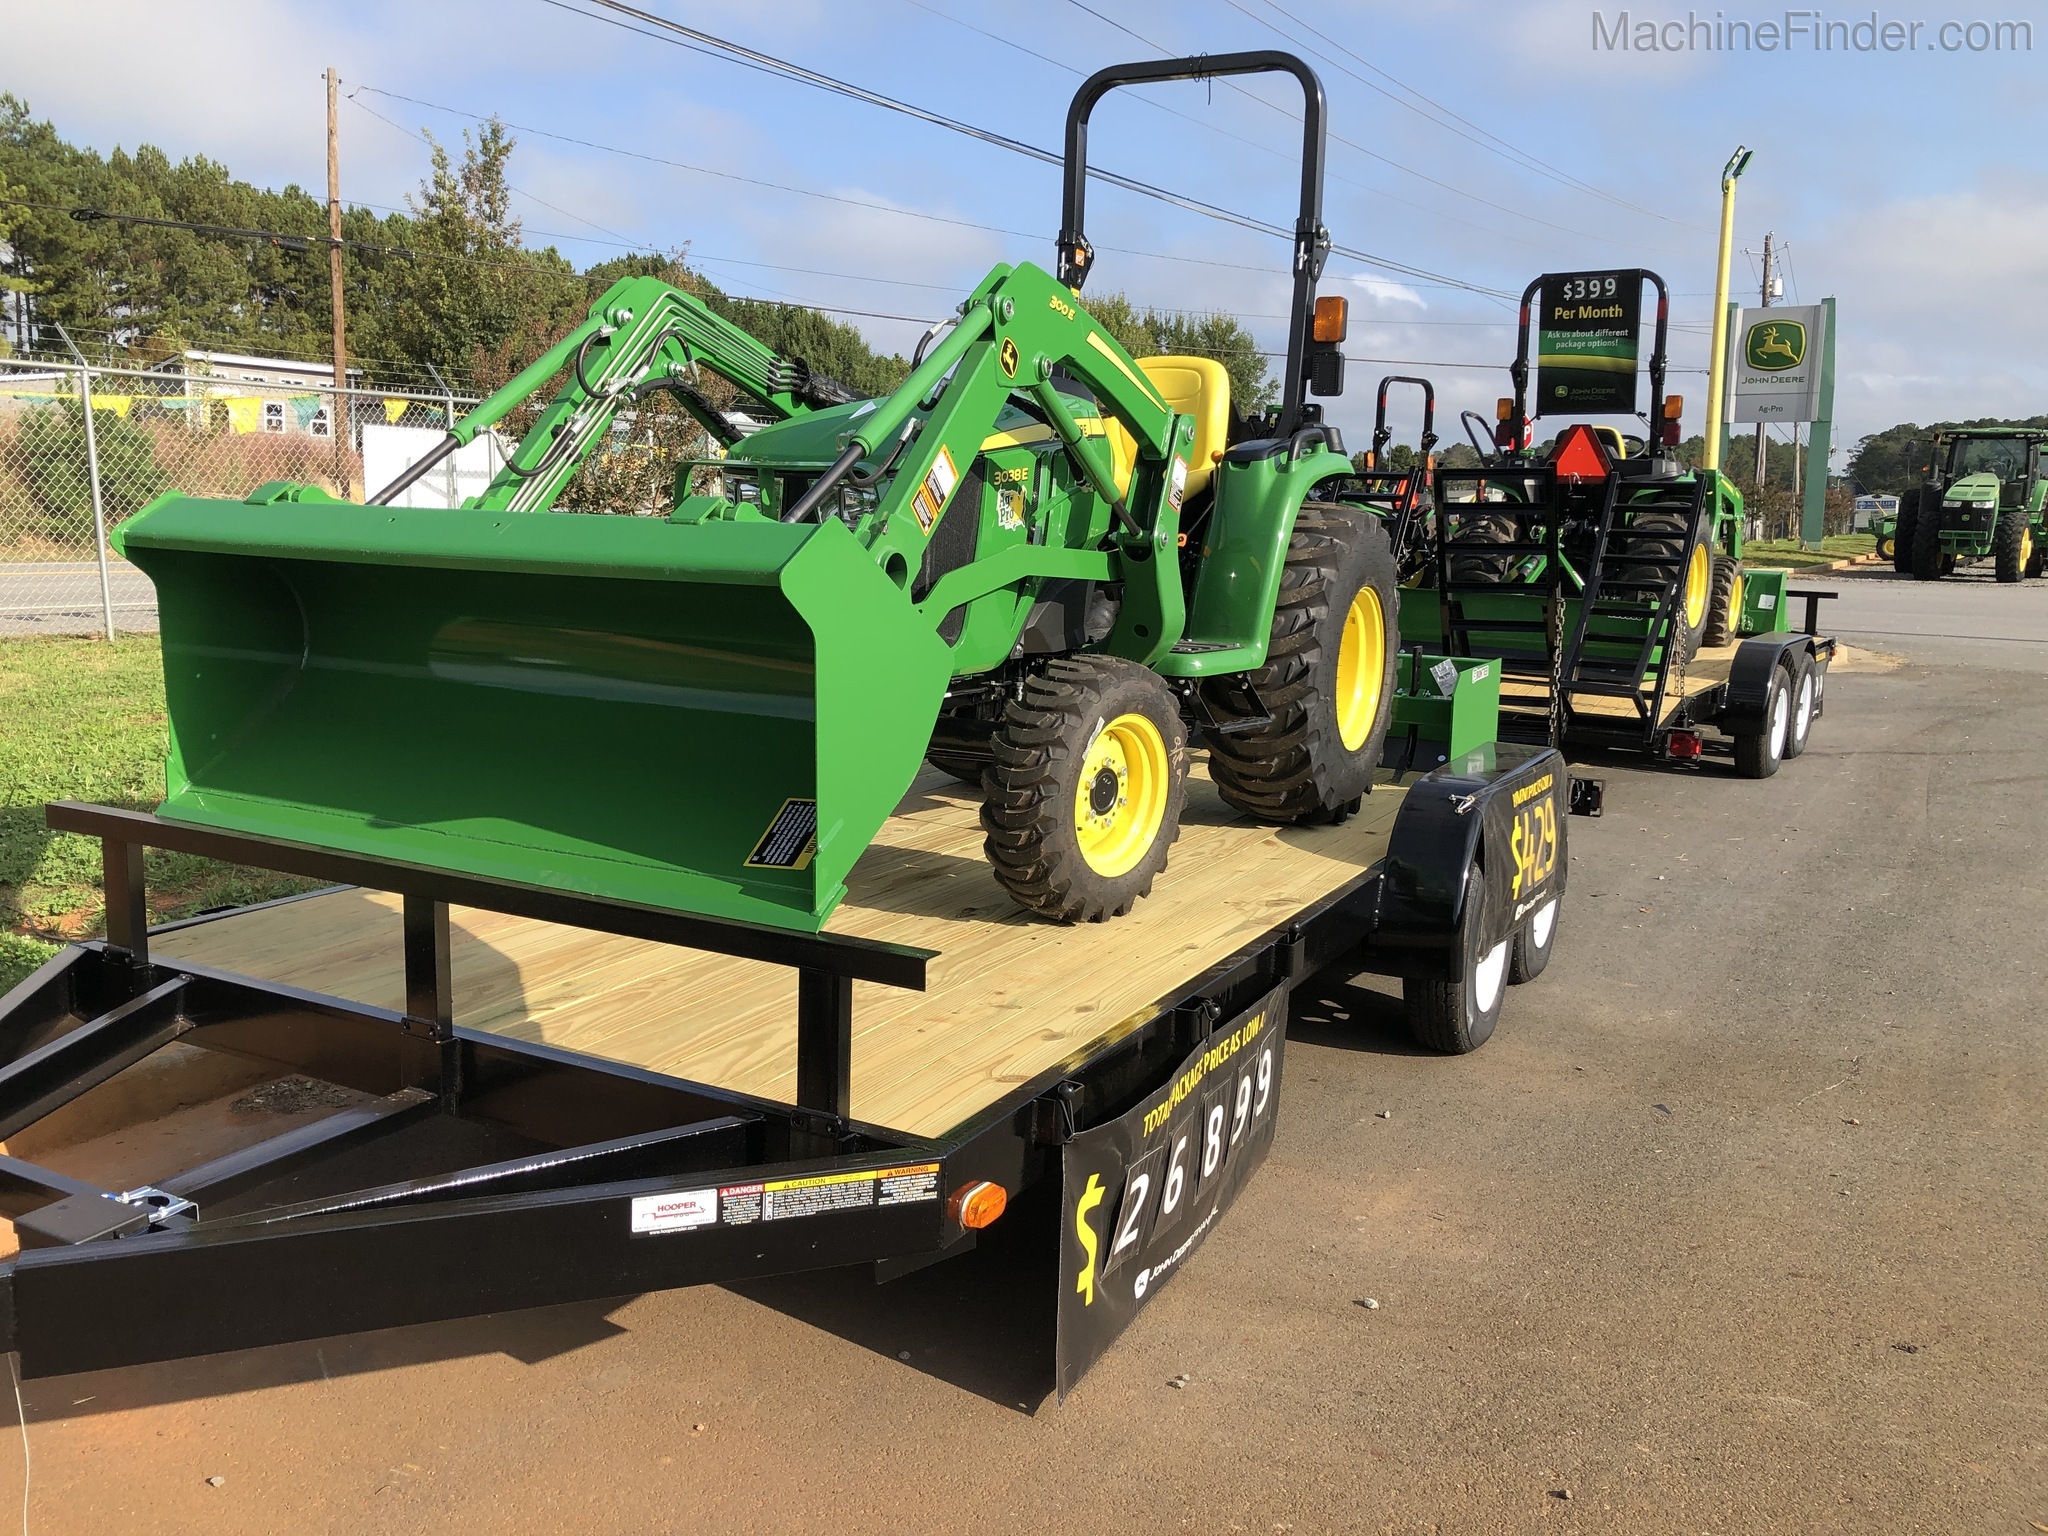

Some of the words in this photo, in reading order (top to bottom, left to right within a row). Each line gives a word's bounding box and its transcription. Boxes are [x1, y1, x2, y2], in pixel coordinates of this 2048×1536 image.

[1563, 278, 1616, 301] $399
[1554, 307, 1576, 320] Per
[1578, 304, 1623, 319] Month
[1571, 330, 1594, 338] about
[1595, 328, 1628, 337] different
[1556, 340, 1585, 350] package
[1587, 339, 1618, 348] options!
[1741, 376, 1769, 384] JOHN
[1770, 376, 1805, 384] DEERE
[1758, 405, 1783, 413] Ag-Pro
[993, 468, 1029, 485] 3038E
[1000, 508, 1014, 522] Pro
[1511, 797, 1557, 900] $429
[1143, 1100, 1170, 1137] TOTA
[1204, 1038, 1230, 1075] PRICE
[1229, 1029, 1241, 1056] AS
[1242, 1014, 1260, 1047] LOW
[894, 1166, 929, 1175] WARNING
[791, 1178, 826, 1188] CAUTION
[729, 1184, 763, 1195] DANGER
[657, 1201, 697, 1212] HOOPER
[649, 1226, 697, 1236] www.hoopertrailer.com
[1149, 1255, 1173, 1281] JOHN
